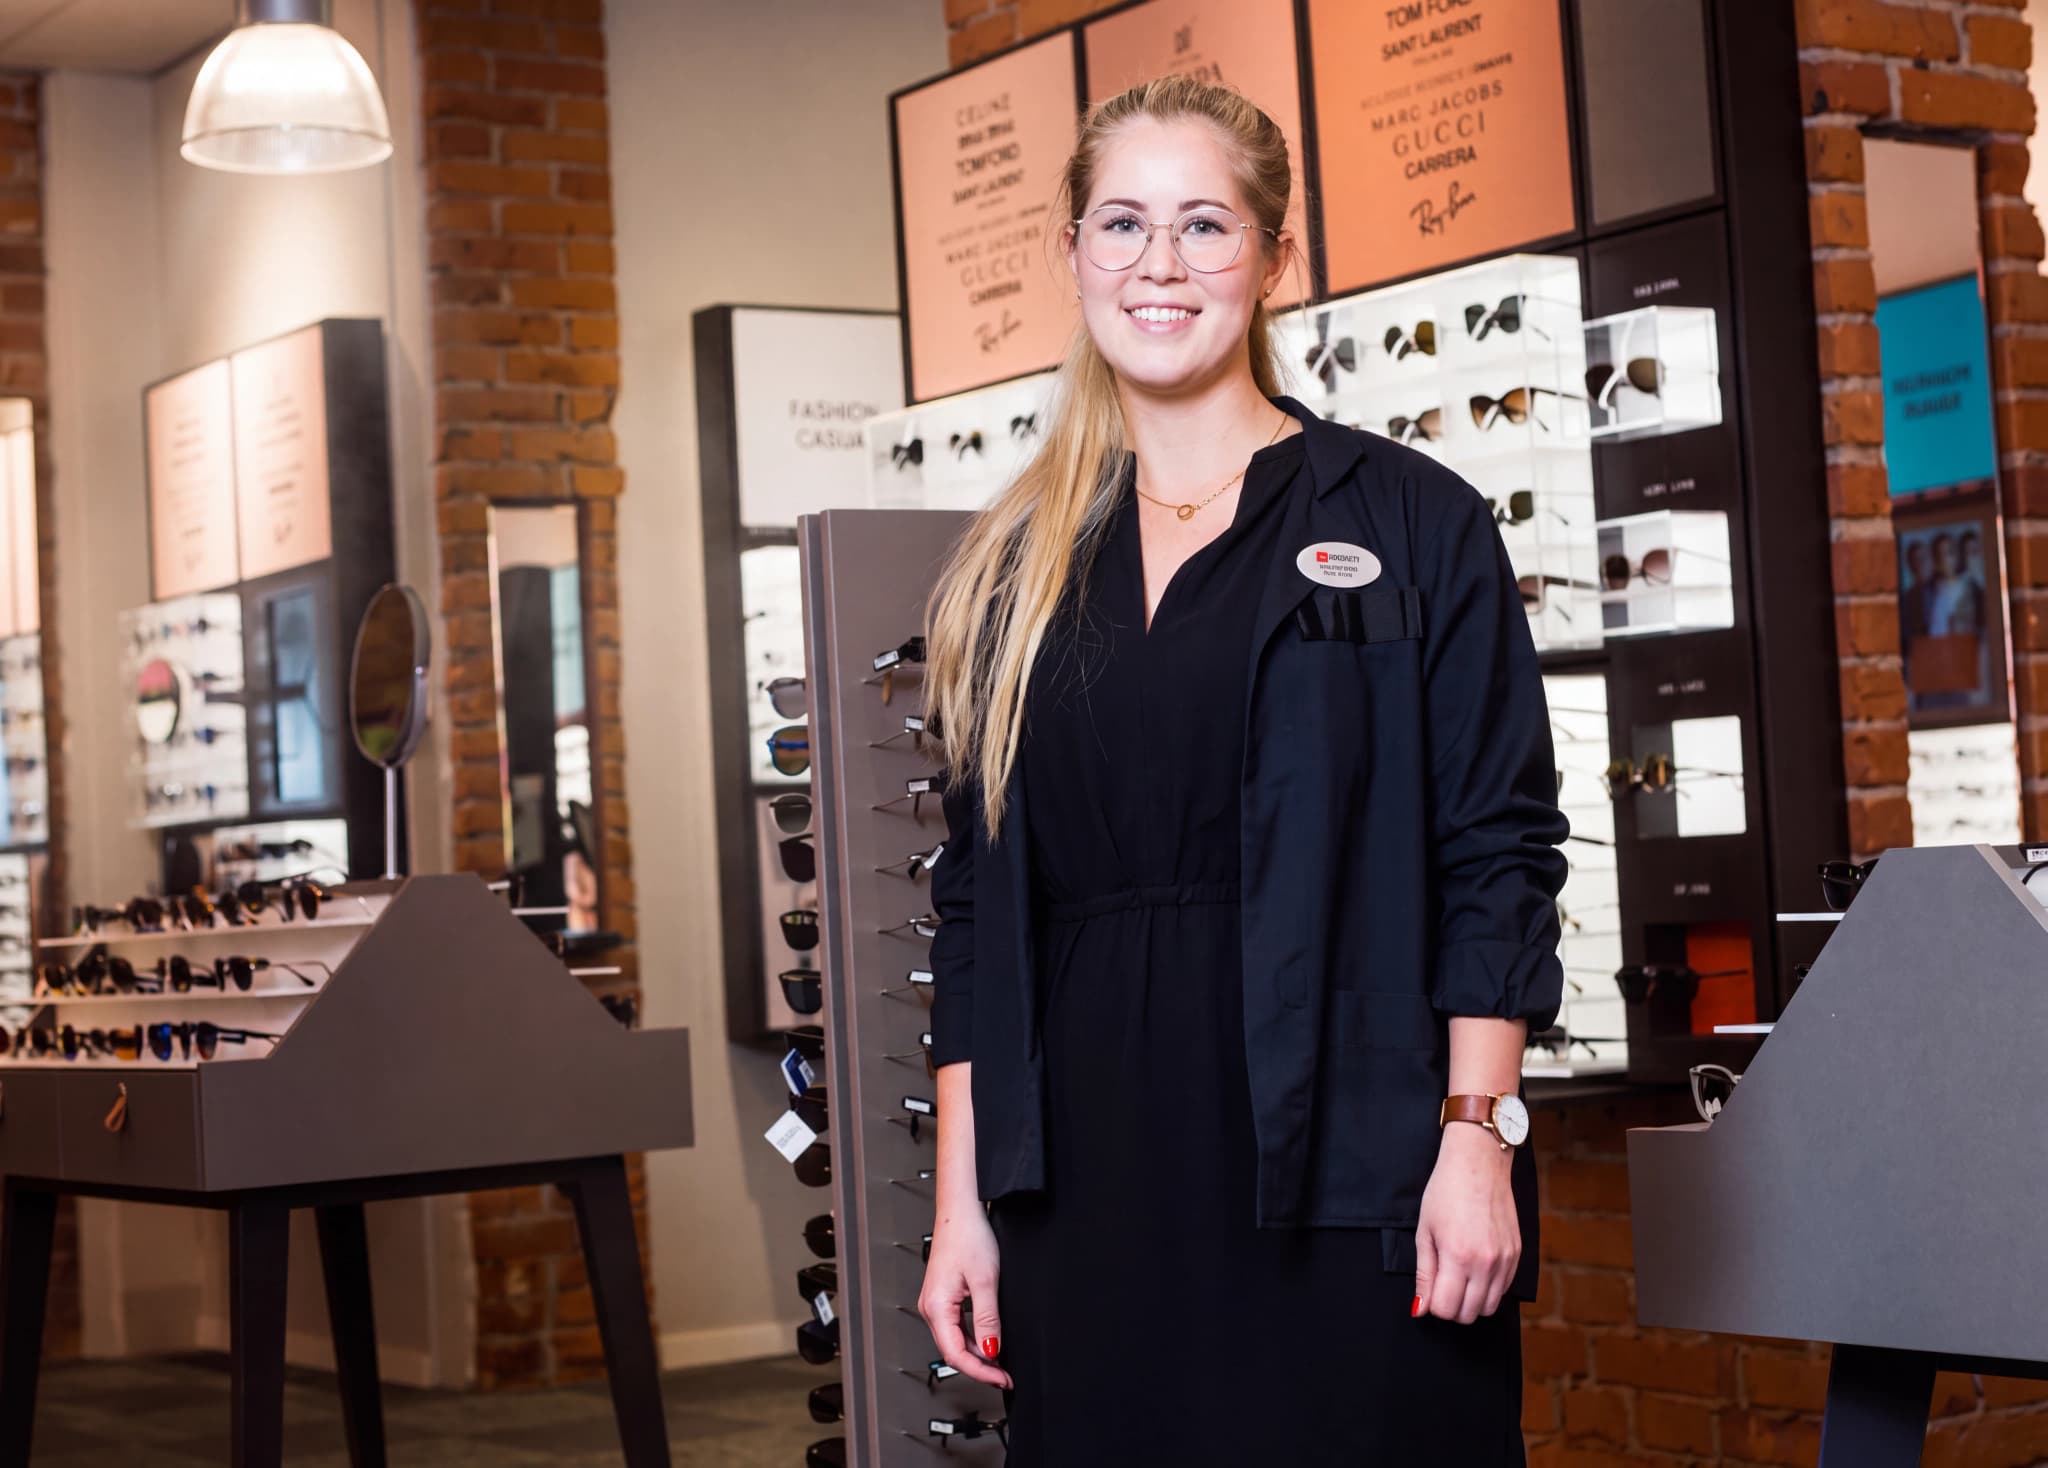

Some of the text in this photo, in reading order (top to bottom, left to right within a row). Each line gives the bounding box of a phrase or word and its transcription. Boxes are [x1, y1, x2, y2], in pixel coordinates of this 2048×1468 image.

[1385, 2, 1422, 30] TOM
[1382, 35, 1416, 62] SAINT
[1421, 13, 1482, 47] LAURENT
[1371, 104, 1421, 132] MARC
[1429, 80, 1503, 117] JACOBS
[1392, 109, 1485, 157] GUCCI
[1405, 145, 1477, 179] CARRERA
[788, 400, 879, 421] FASHION
[795, 429, 866, 450] CASUA
